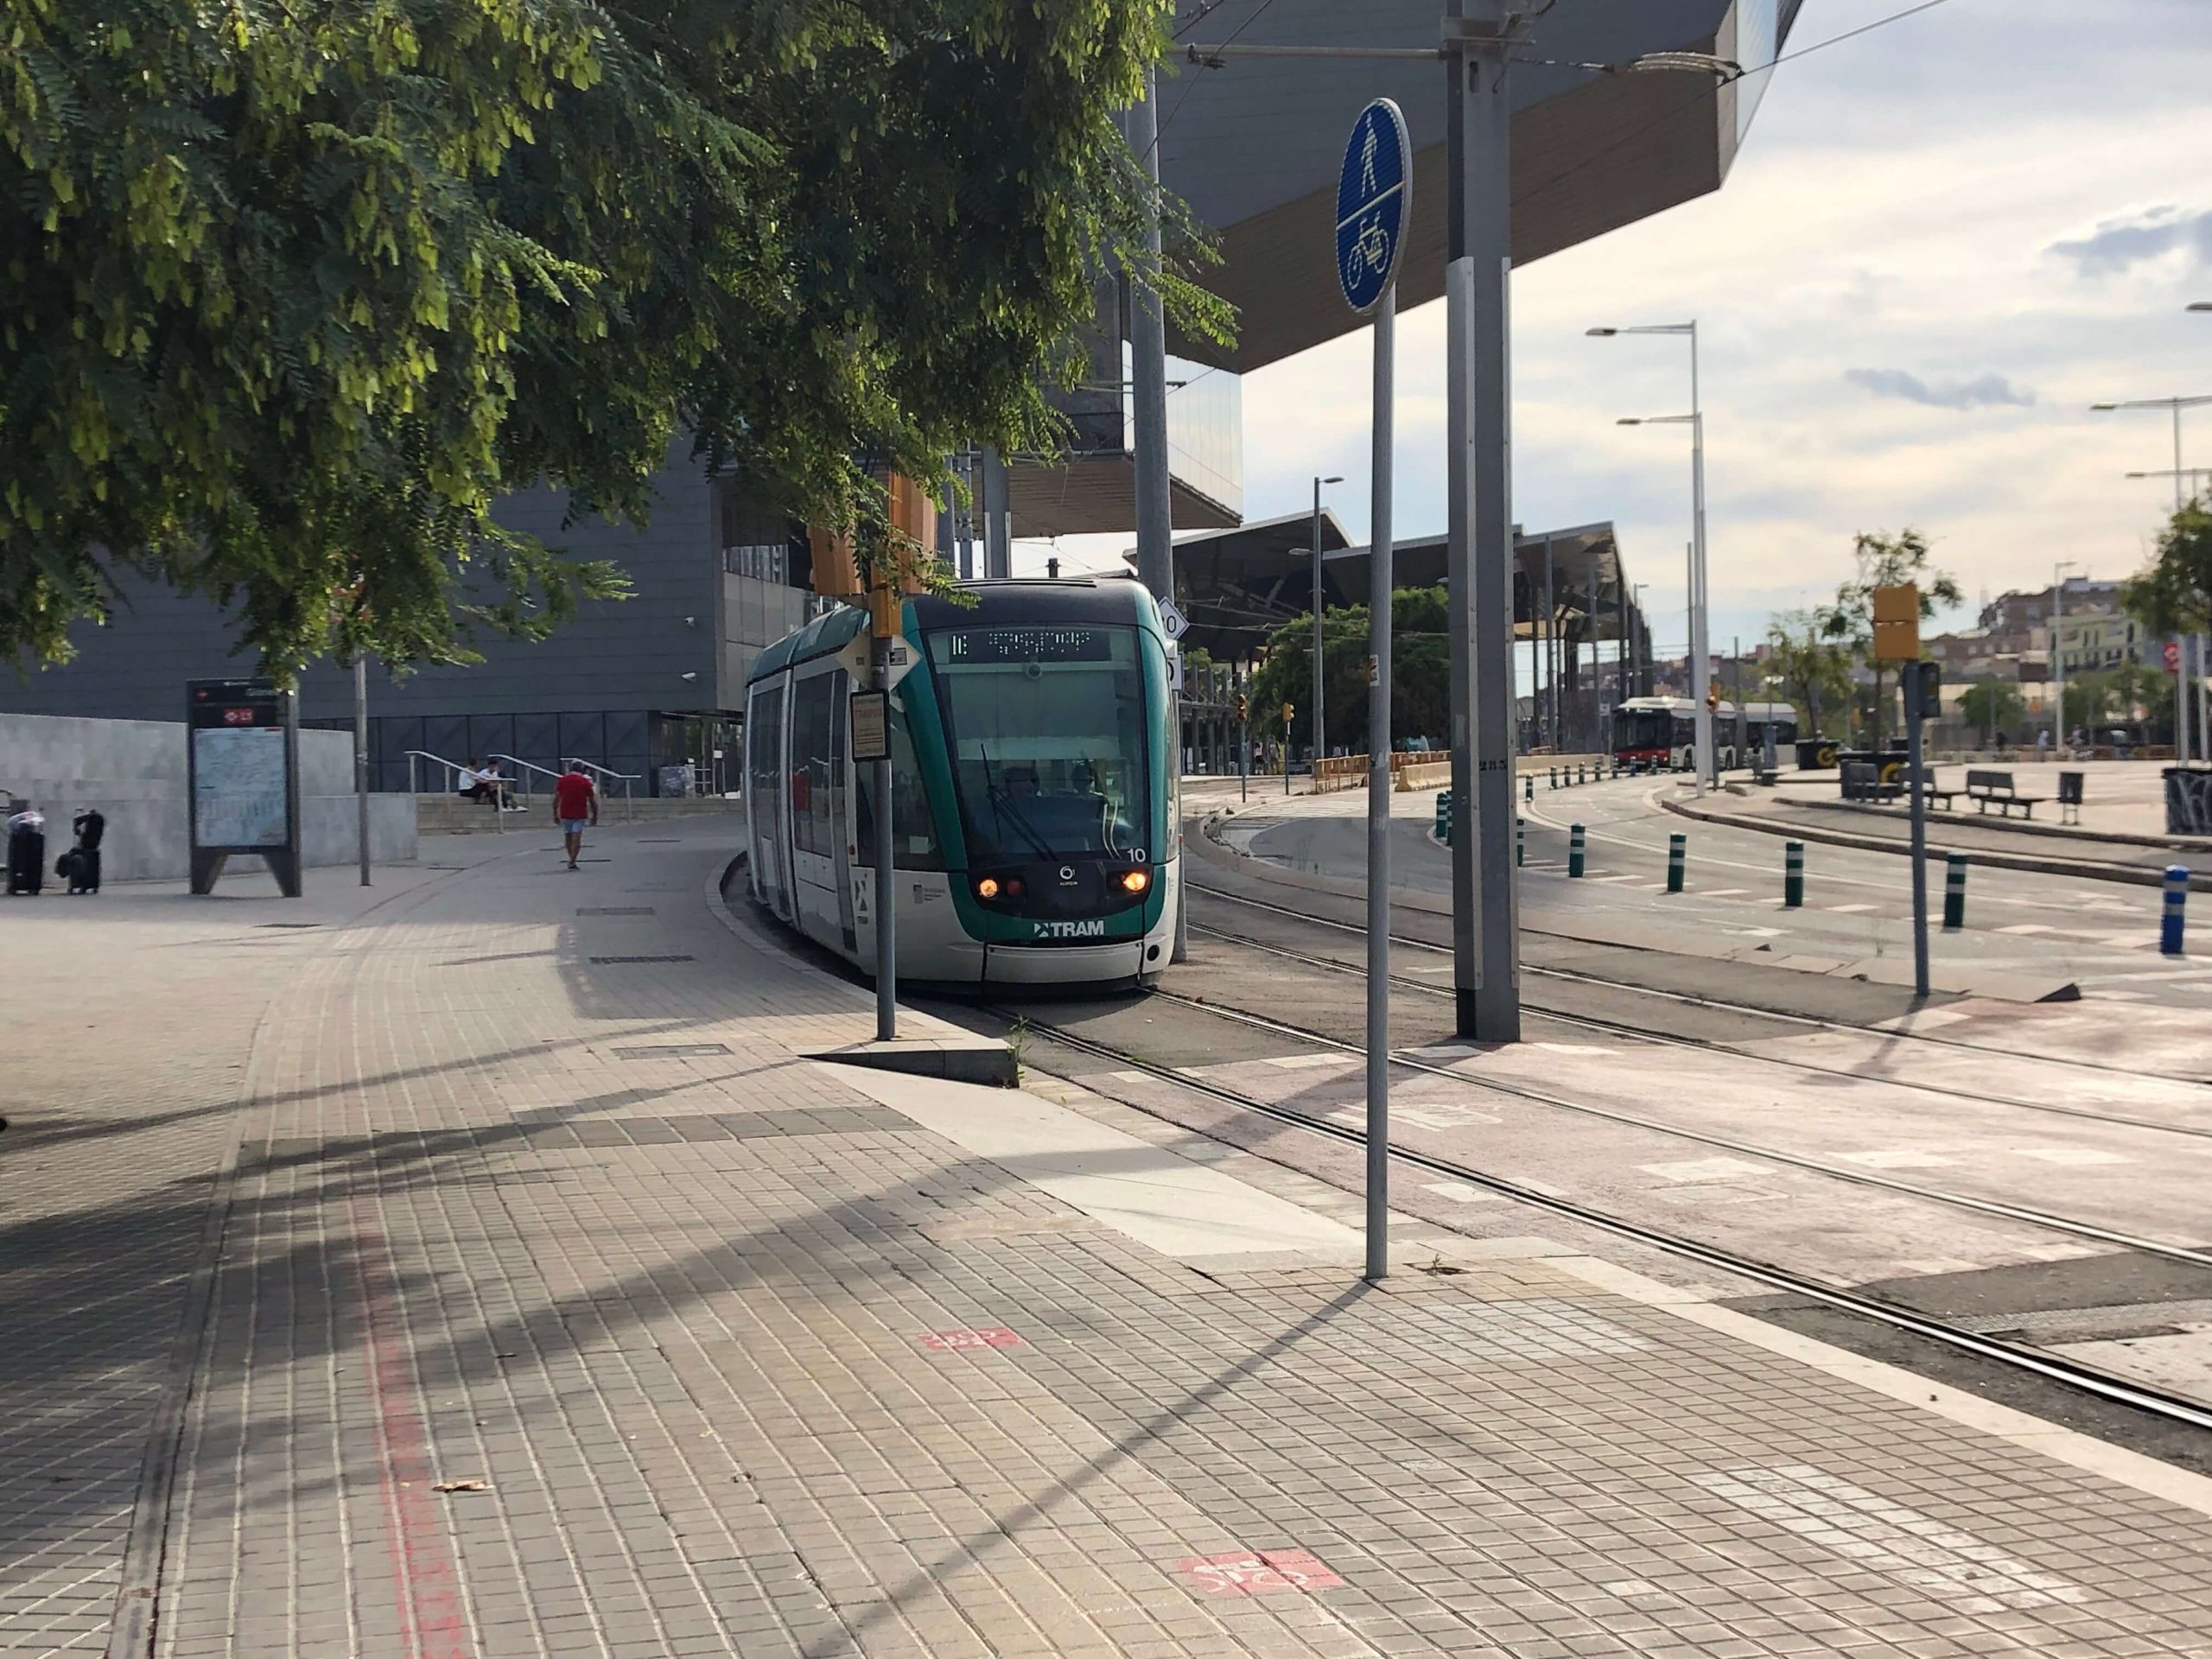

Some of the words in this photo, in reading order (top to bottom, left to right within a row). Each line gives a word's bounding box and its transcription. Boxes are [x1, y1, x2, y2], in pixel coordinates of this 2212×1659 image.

[1162, 615, 1177, 633] 0
[1127, 848, 1147, 862] 10
[1050, 920, 1104, 937] TRAM
